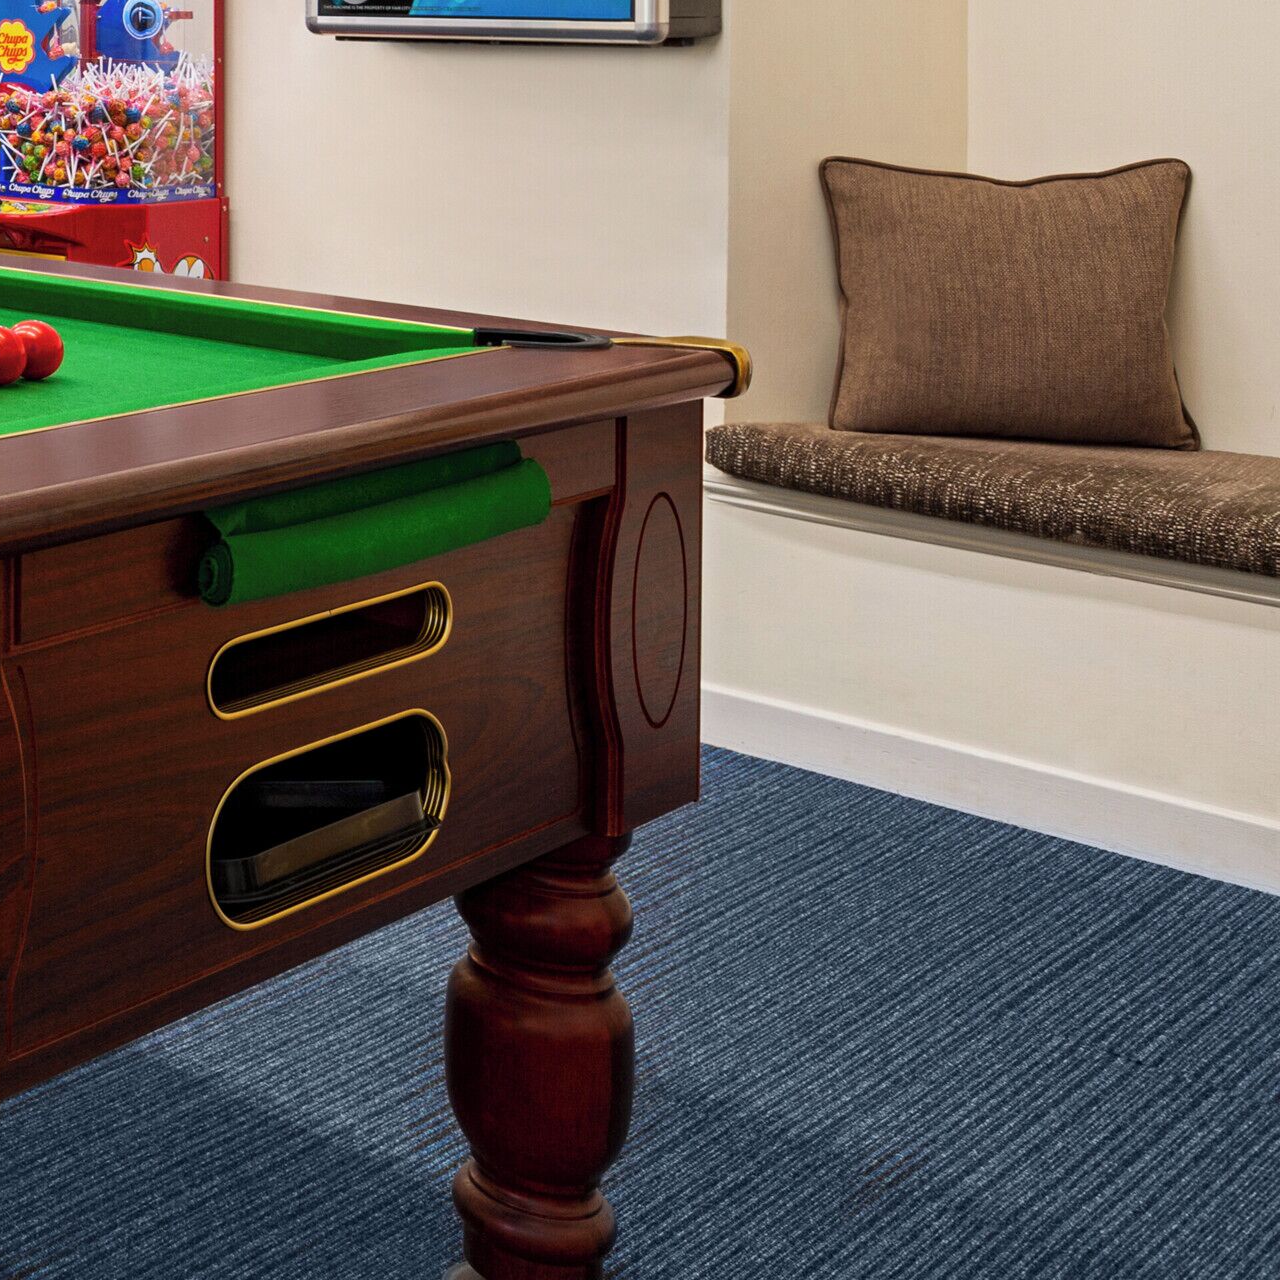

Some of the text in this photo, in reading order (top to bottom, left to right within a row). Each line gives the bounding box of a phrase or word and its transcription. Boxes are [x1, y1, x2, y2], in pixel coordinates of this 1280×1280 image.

[8, 183, 55, 199] Chupa Chups
[128, 190, 151, 200] Chup
